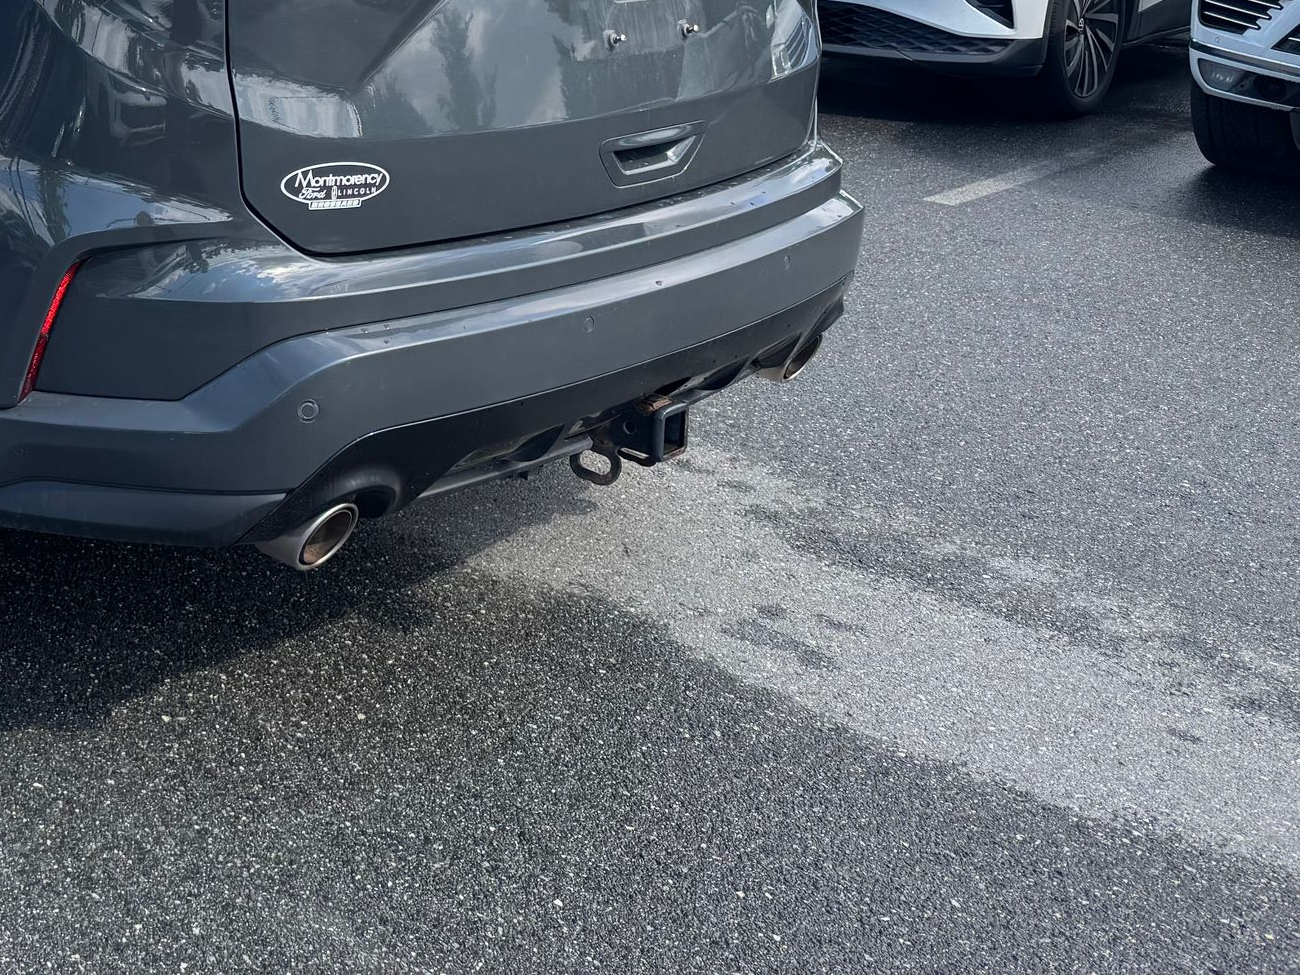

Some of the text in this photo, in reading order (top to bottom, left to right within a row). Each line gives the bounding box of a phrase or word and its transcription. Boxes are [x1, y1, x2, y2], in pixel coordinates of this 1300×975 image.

[294, 170, 383, 188] Montmorency
[298, 186, 377, 199] Ford LINCOLN
